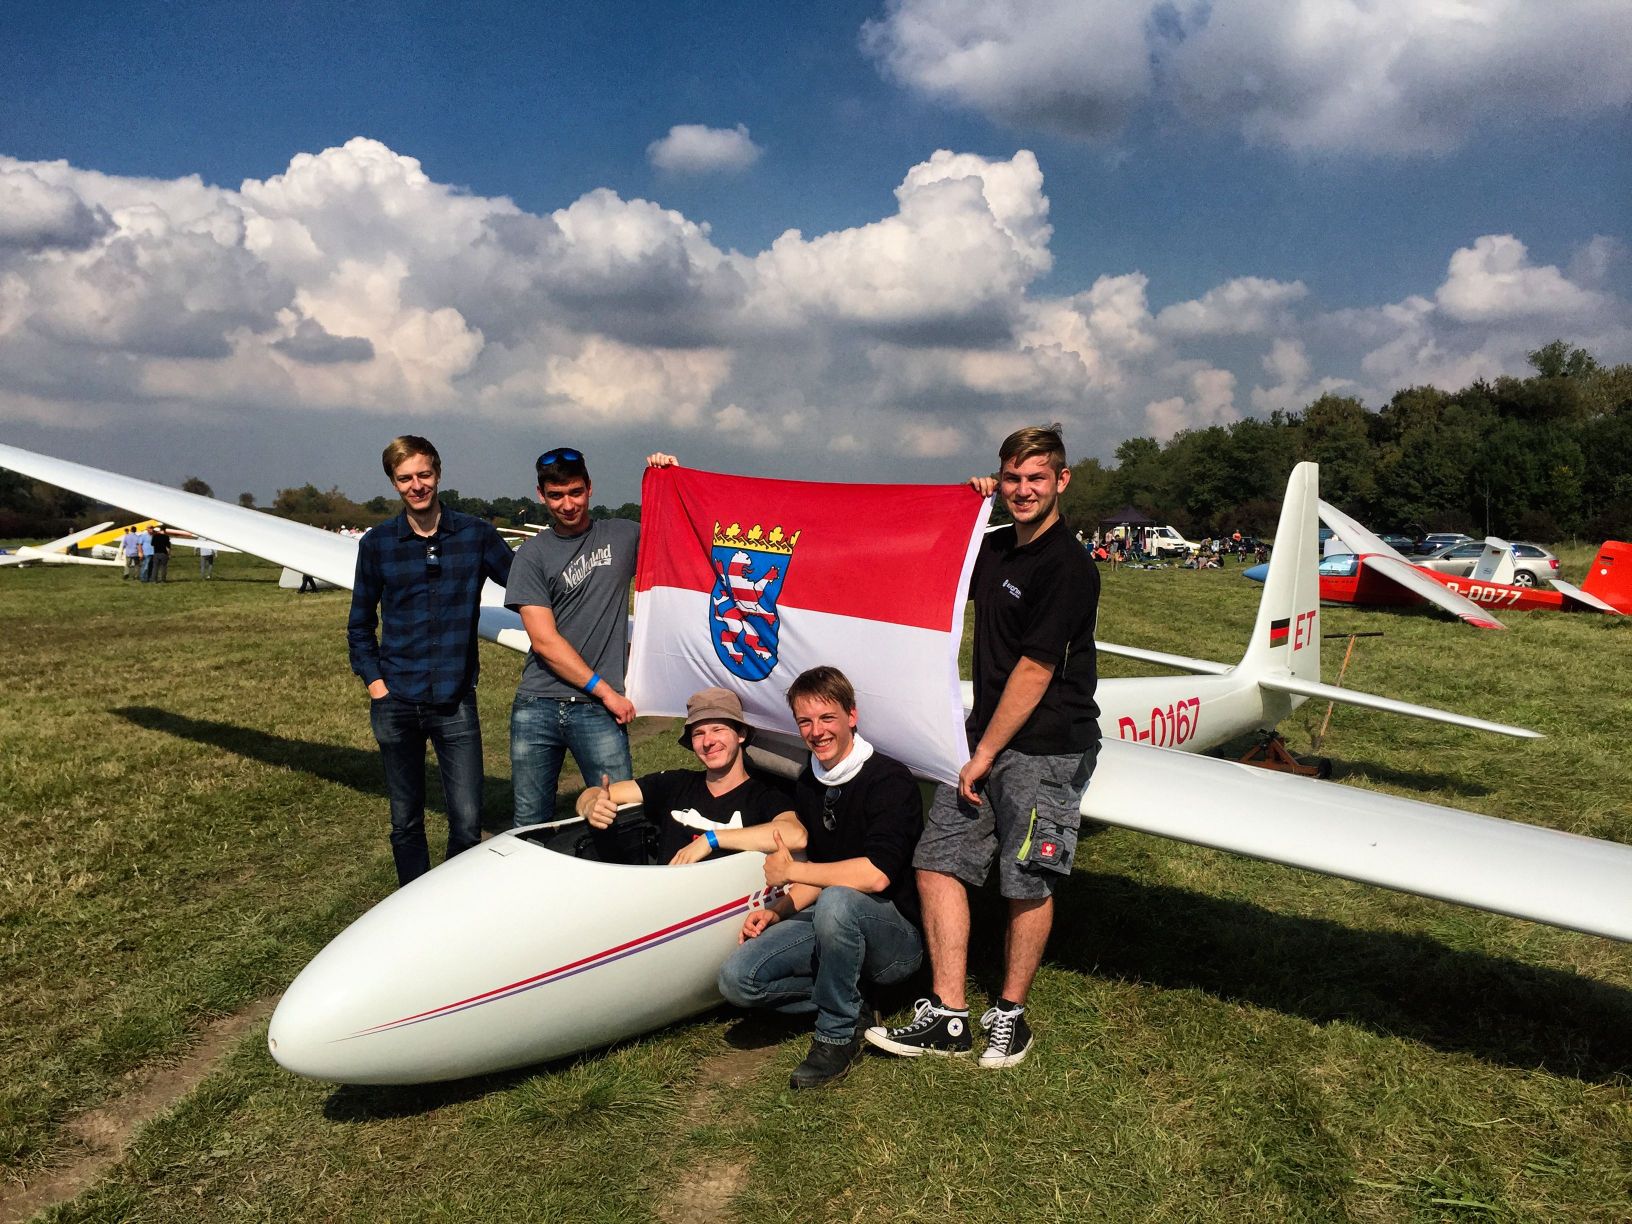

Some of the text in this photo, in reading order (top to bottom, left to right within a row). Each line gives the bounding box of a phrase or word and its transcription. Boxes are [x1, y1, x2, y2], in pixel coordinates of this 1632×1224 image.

[562, 567, 584, 593] New
[1294, 610, 1316, 651] ET
[1118, 697, 1200, 748] D-0167
